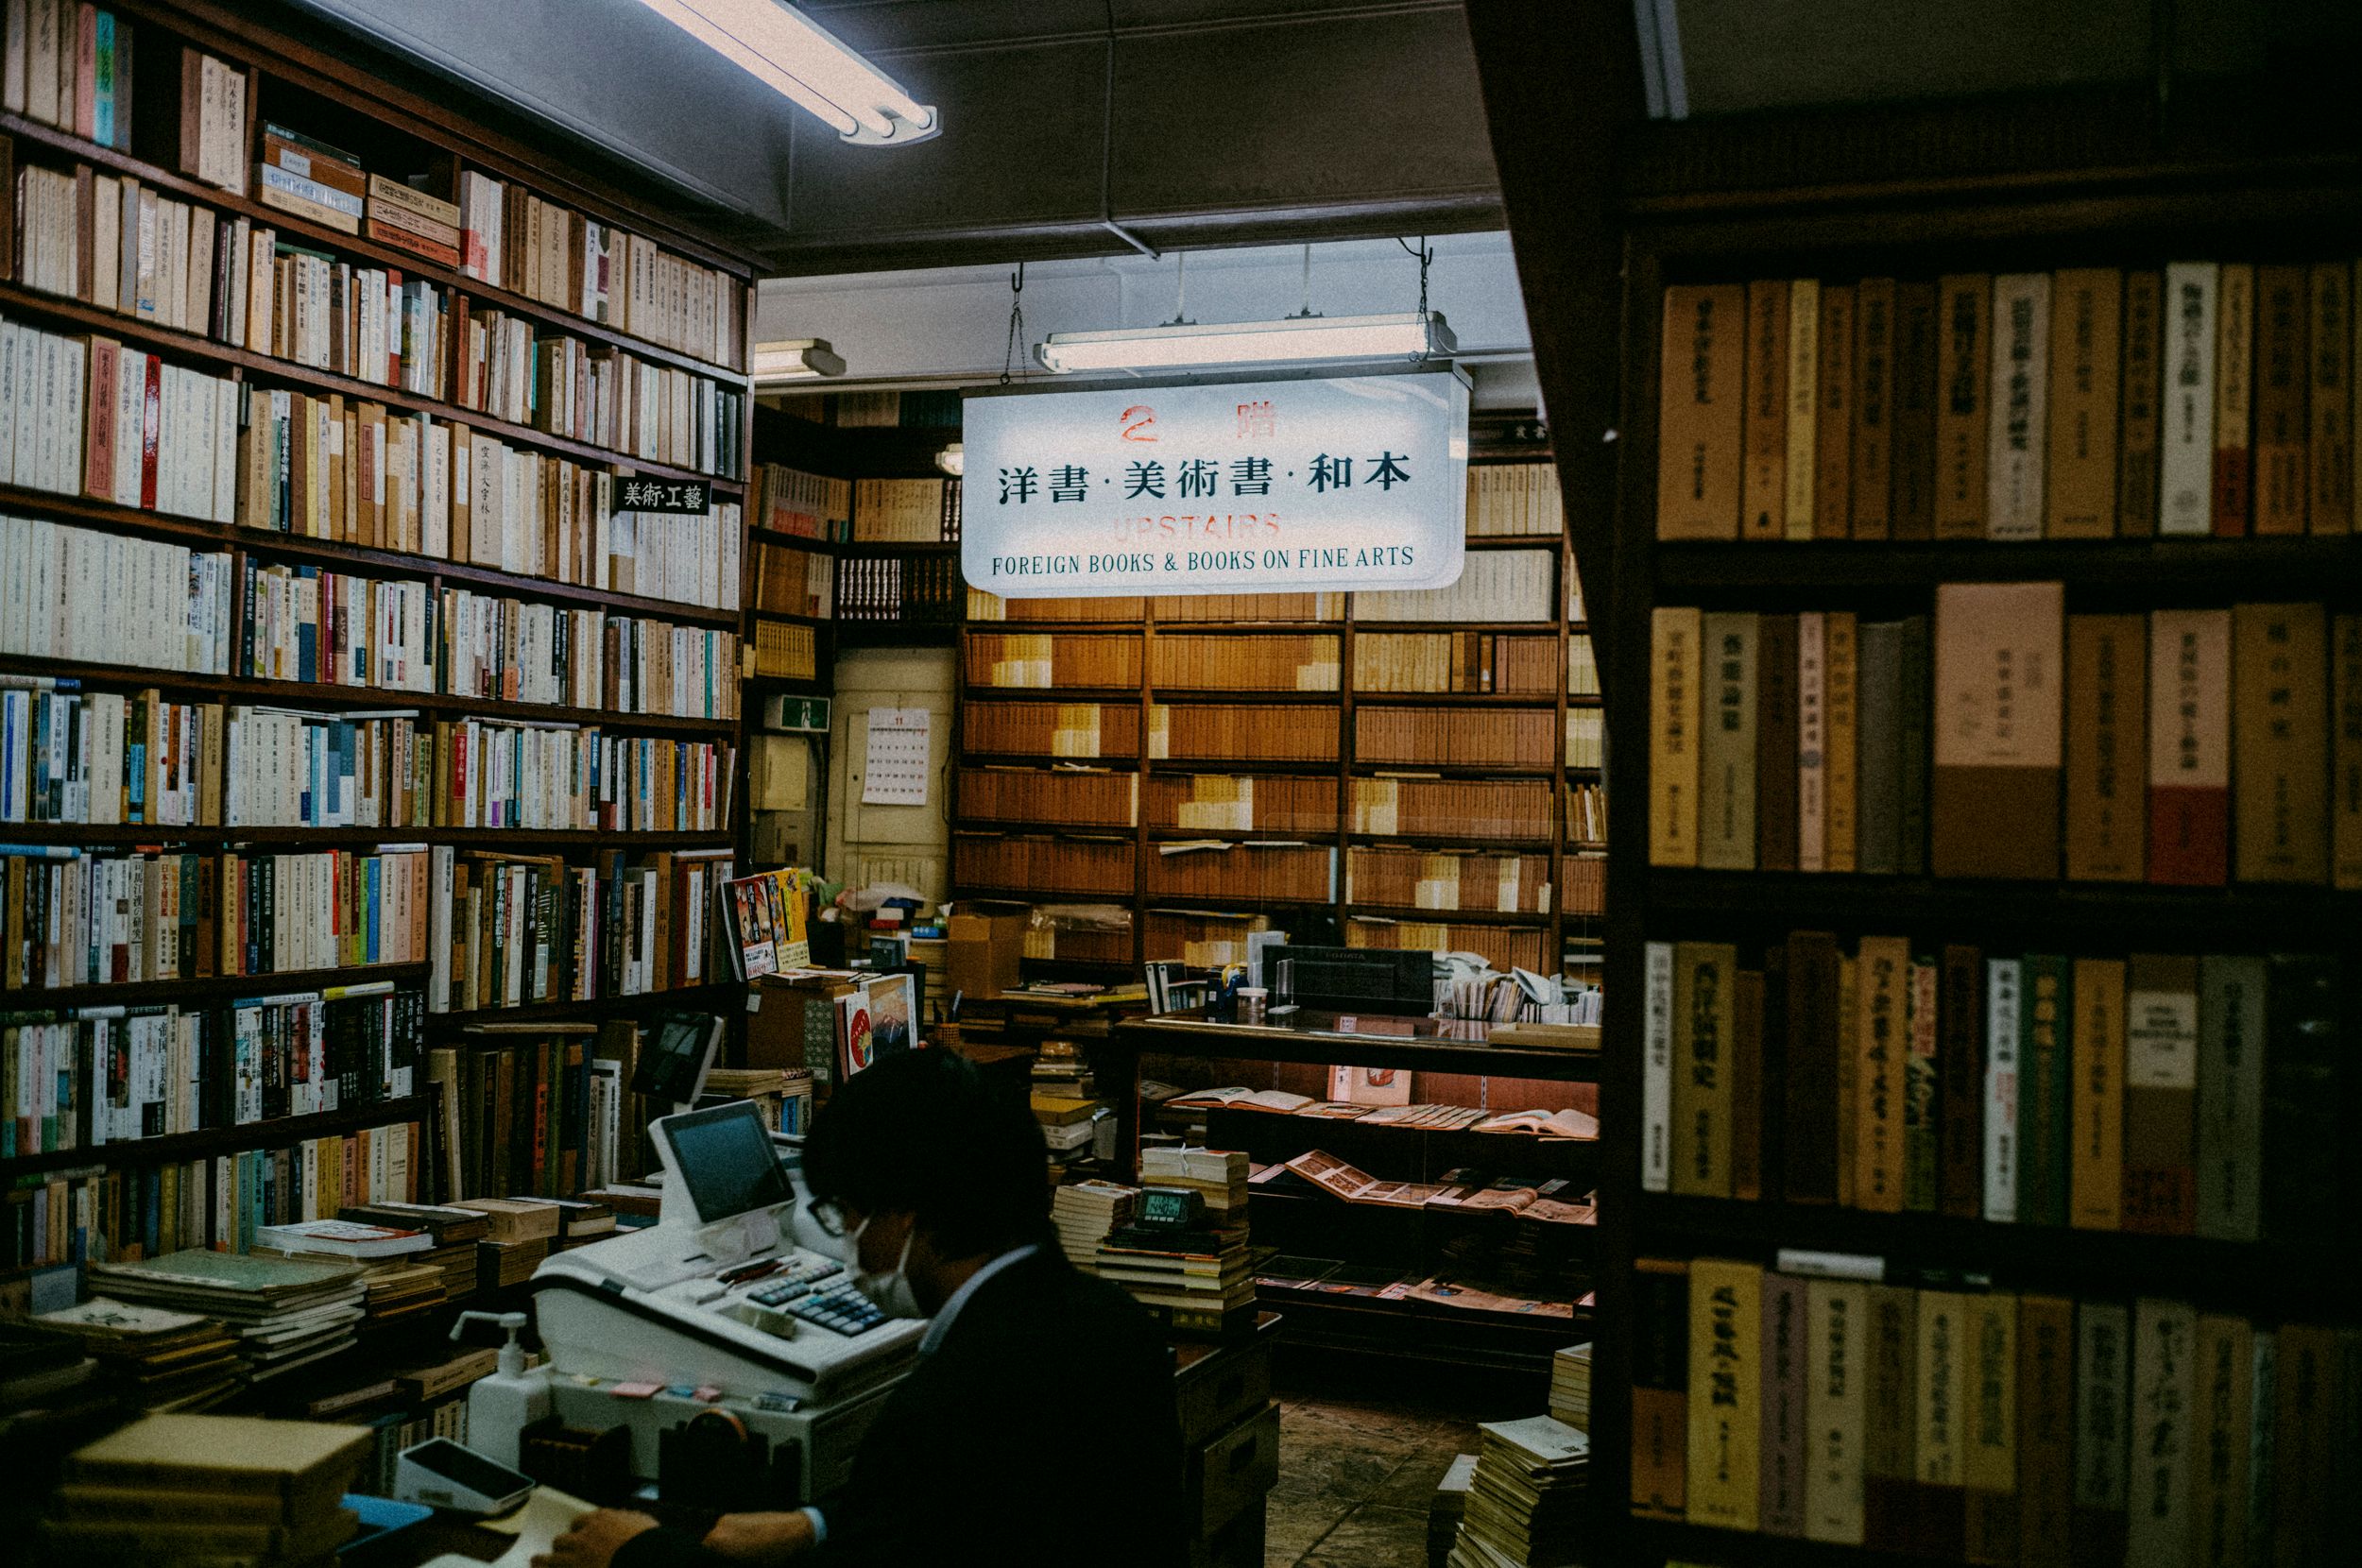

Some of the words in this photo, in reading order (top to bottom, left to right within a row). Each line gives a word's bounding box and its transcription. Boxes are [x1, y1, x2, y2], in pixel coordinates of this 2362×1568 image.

[1120, 405, 1157, 442] 2
[1114, 513, 1282, 545] UPSTAIRS
[992, 556, 1079, 575] FOREIGN
[1089, 554, 1154, 572] BOOKS
[1164, 553, 1178, 571] &
[1189, 551, 1255, 570] BOOKS
[1263, 550, 1289, 568] ON
[1299, 548, 1348, 567] FINE
[1355, 546, 1413, 566] ARTS
[895, 717, 903, 725] 11
